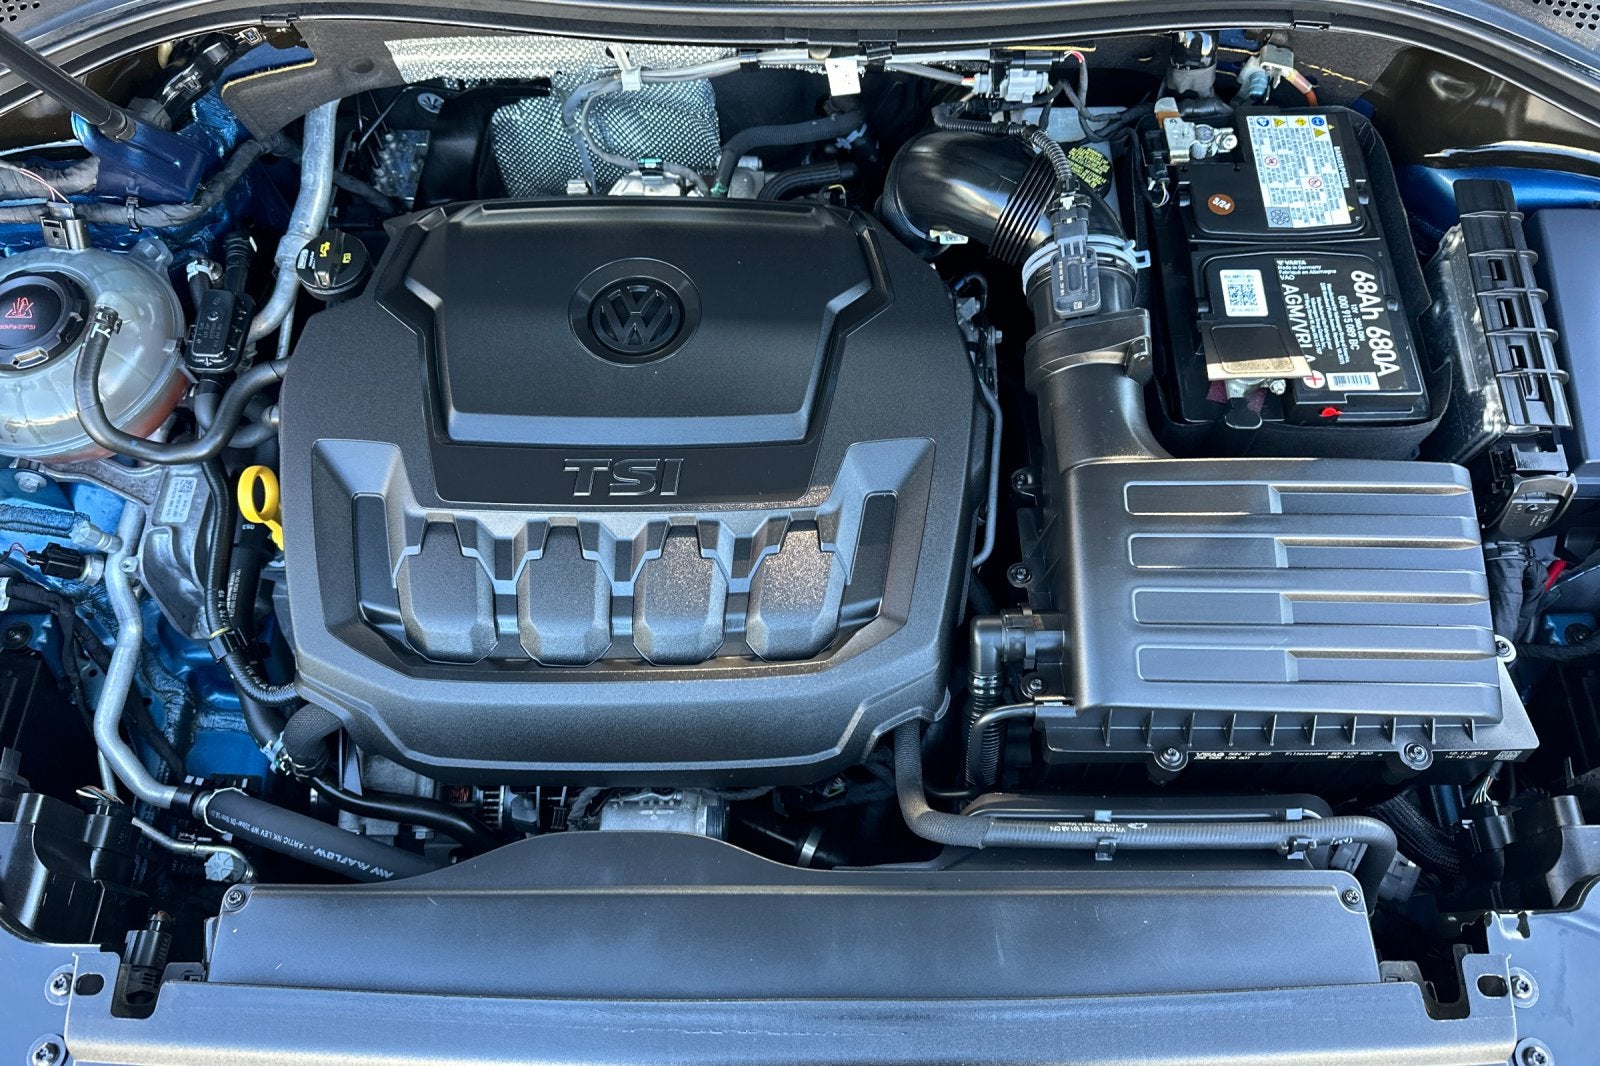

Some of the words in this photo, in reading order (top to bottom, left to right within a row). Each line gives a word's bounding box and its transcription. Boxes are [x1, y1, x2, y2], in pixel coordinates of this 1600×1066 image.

[1337, 295, 1349, 308] 000
[1349, 270, 1385, 319] 68Ah
[1341, 309, 1352, 322] 915
[1344, 323, 1356, 337] 089
[1348, 338, 1359, 350] BC
[1364, 326, 1401, 376] 680A
[563, 458, 684, 496] TSI
[313, 846, 370, 871] MAFLOW
